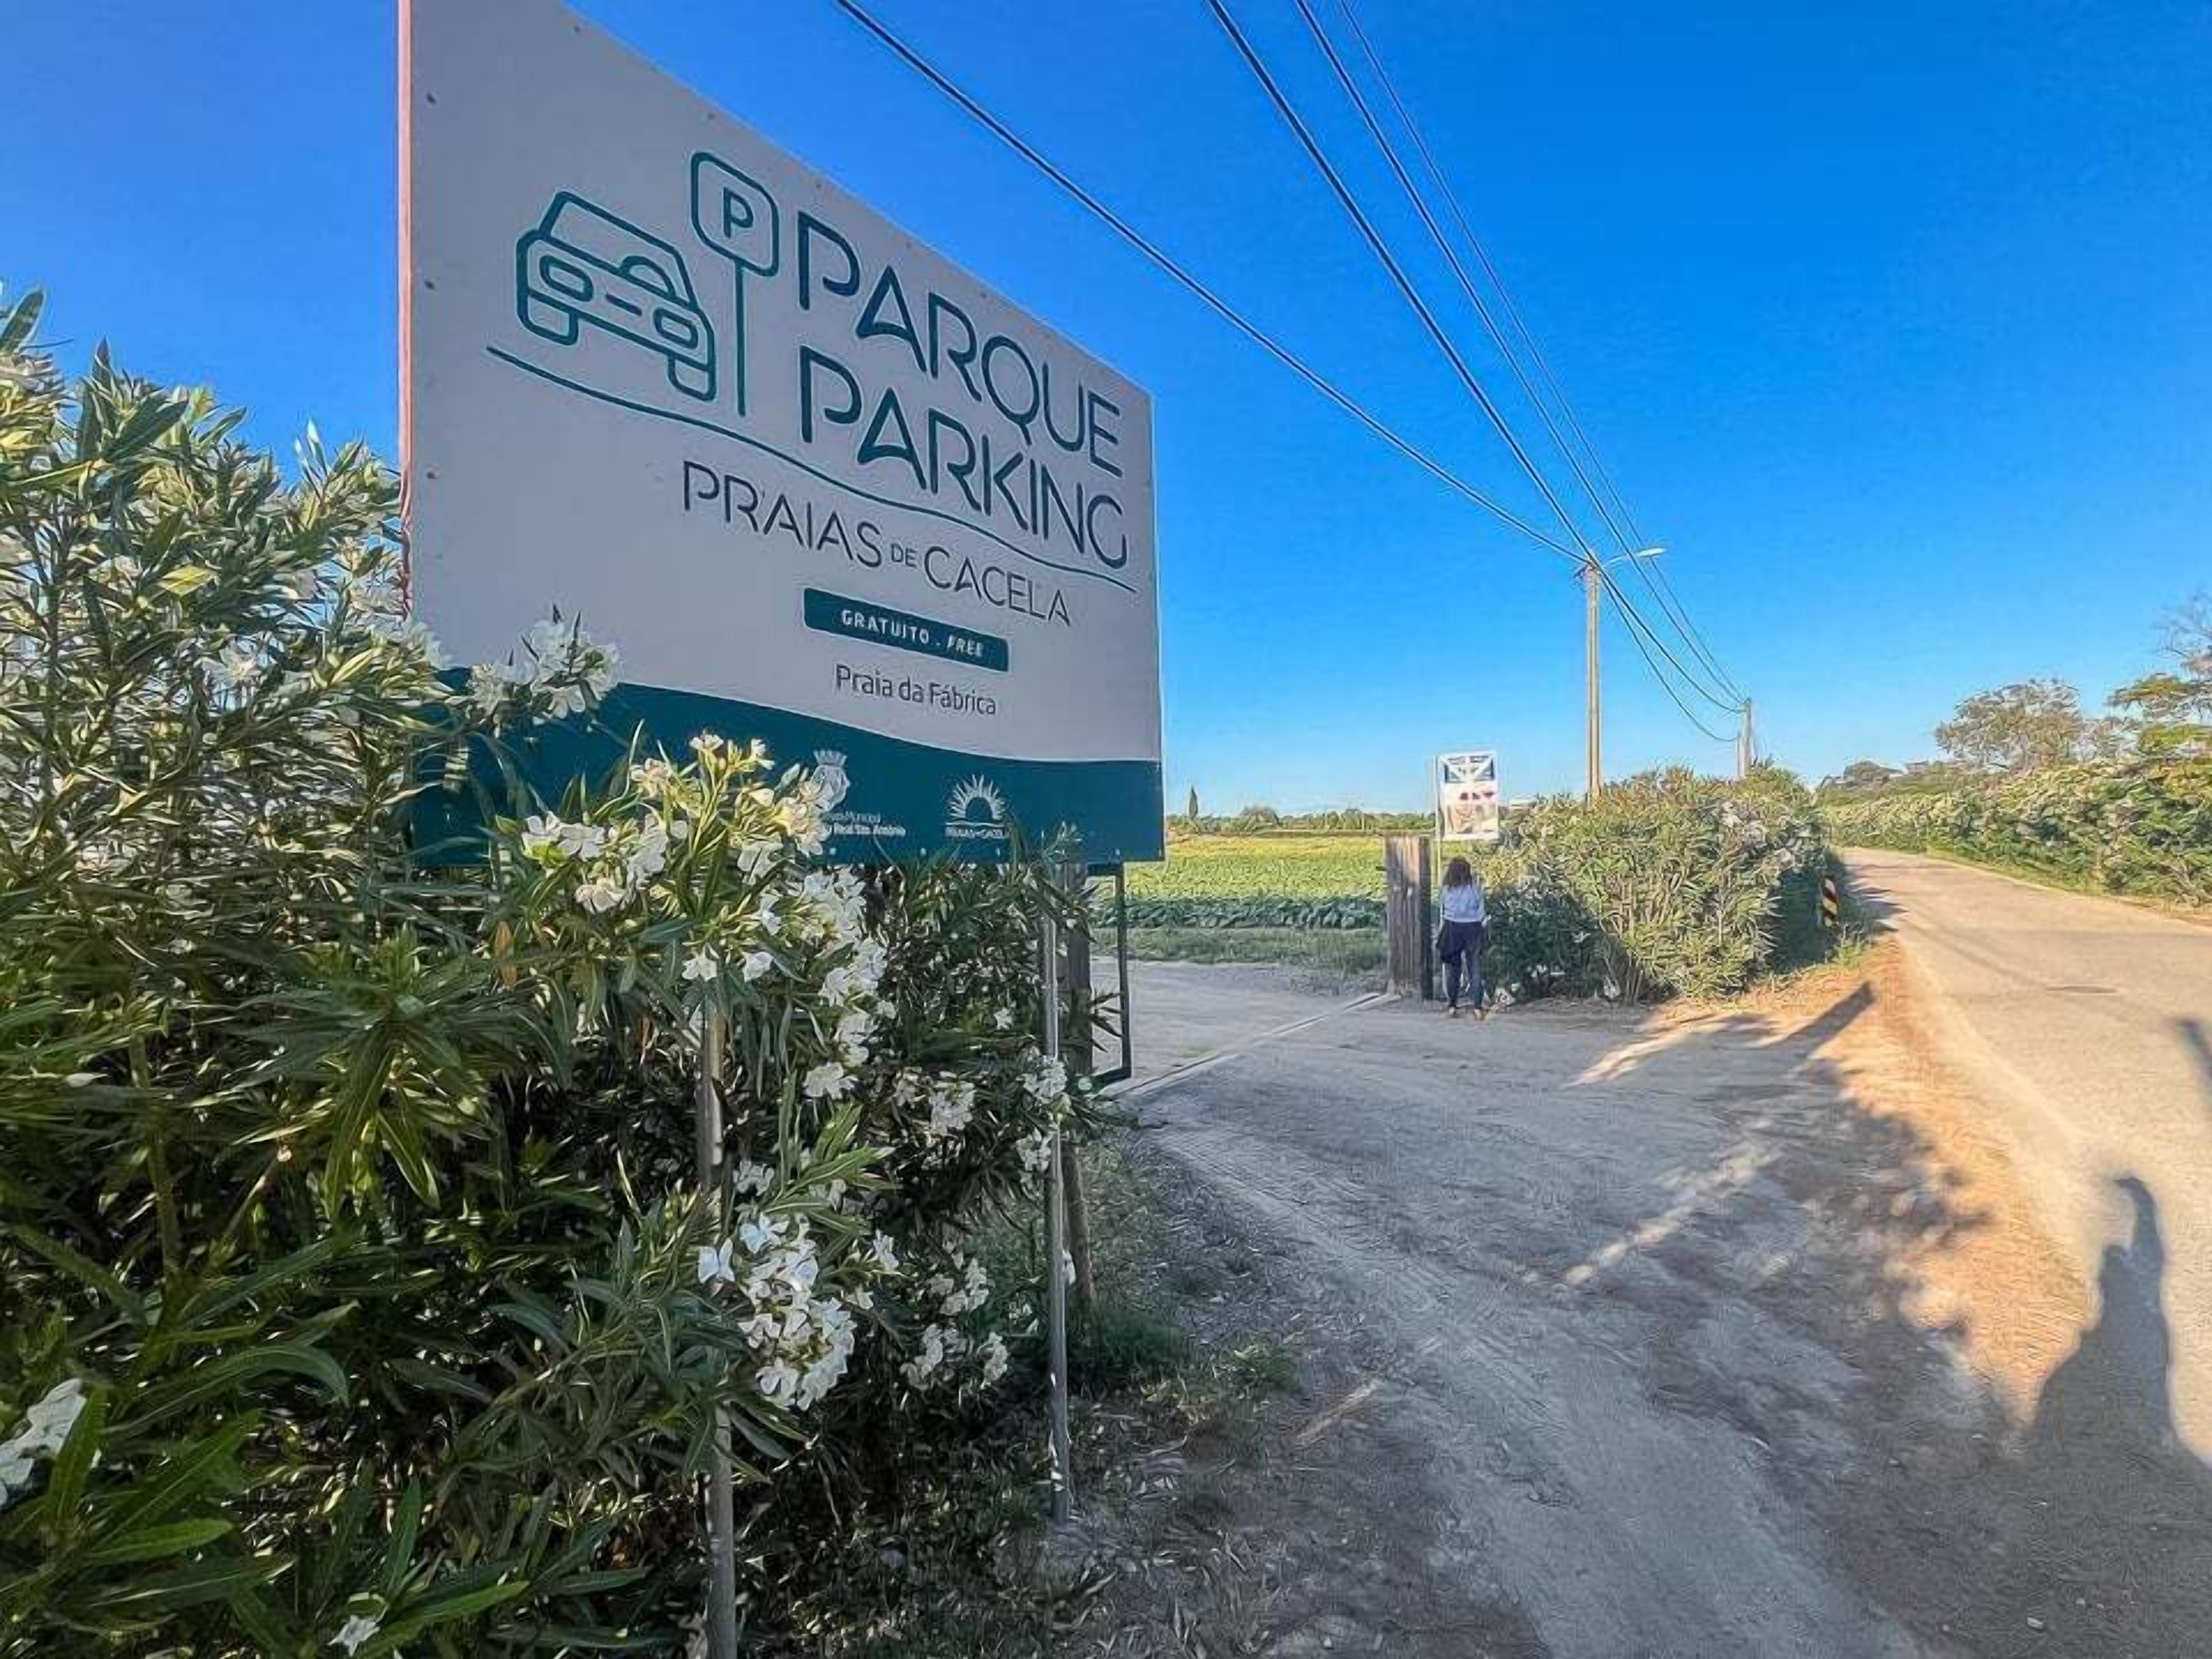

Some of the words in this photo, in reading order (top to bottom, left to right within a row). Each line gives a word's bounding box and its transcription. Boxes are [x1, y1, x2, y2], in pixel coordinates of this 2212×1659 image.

[798, 210, 1123, 478] PARQUE
[799, 346, 1127, 569] PARKING
[683, 460, 882, 568] PRAIAS
[891, 543, 918, 568] DE
[924, 546, 1072, 627] CACELA
[835, 663, 894, 698] Praia
[898, 677, 925, 703] da
[929, 681, 997, 715] Fábrica
[840, 608, 930, 645] GRATUITO
[946, 635, 984, 657] FREE
